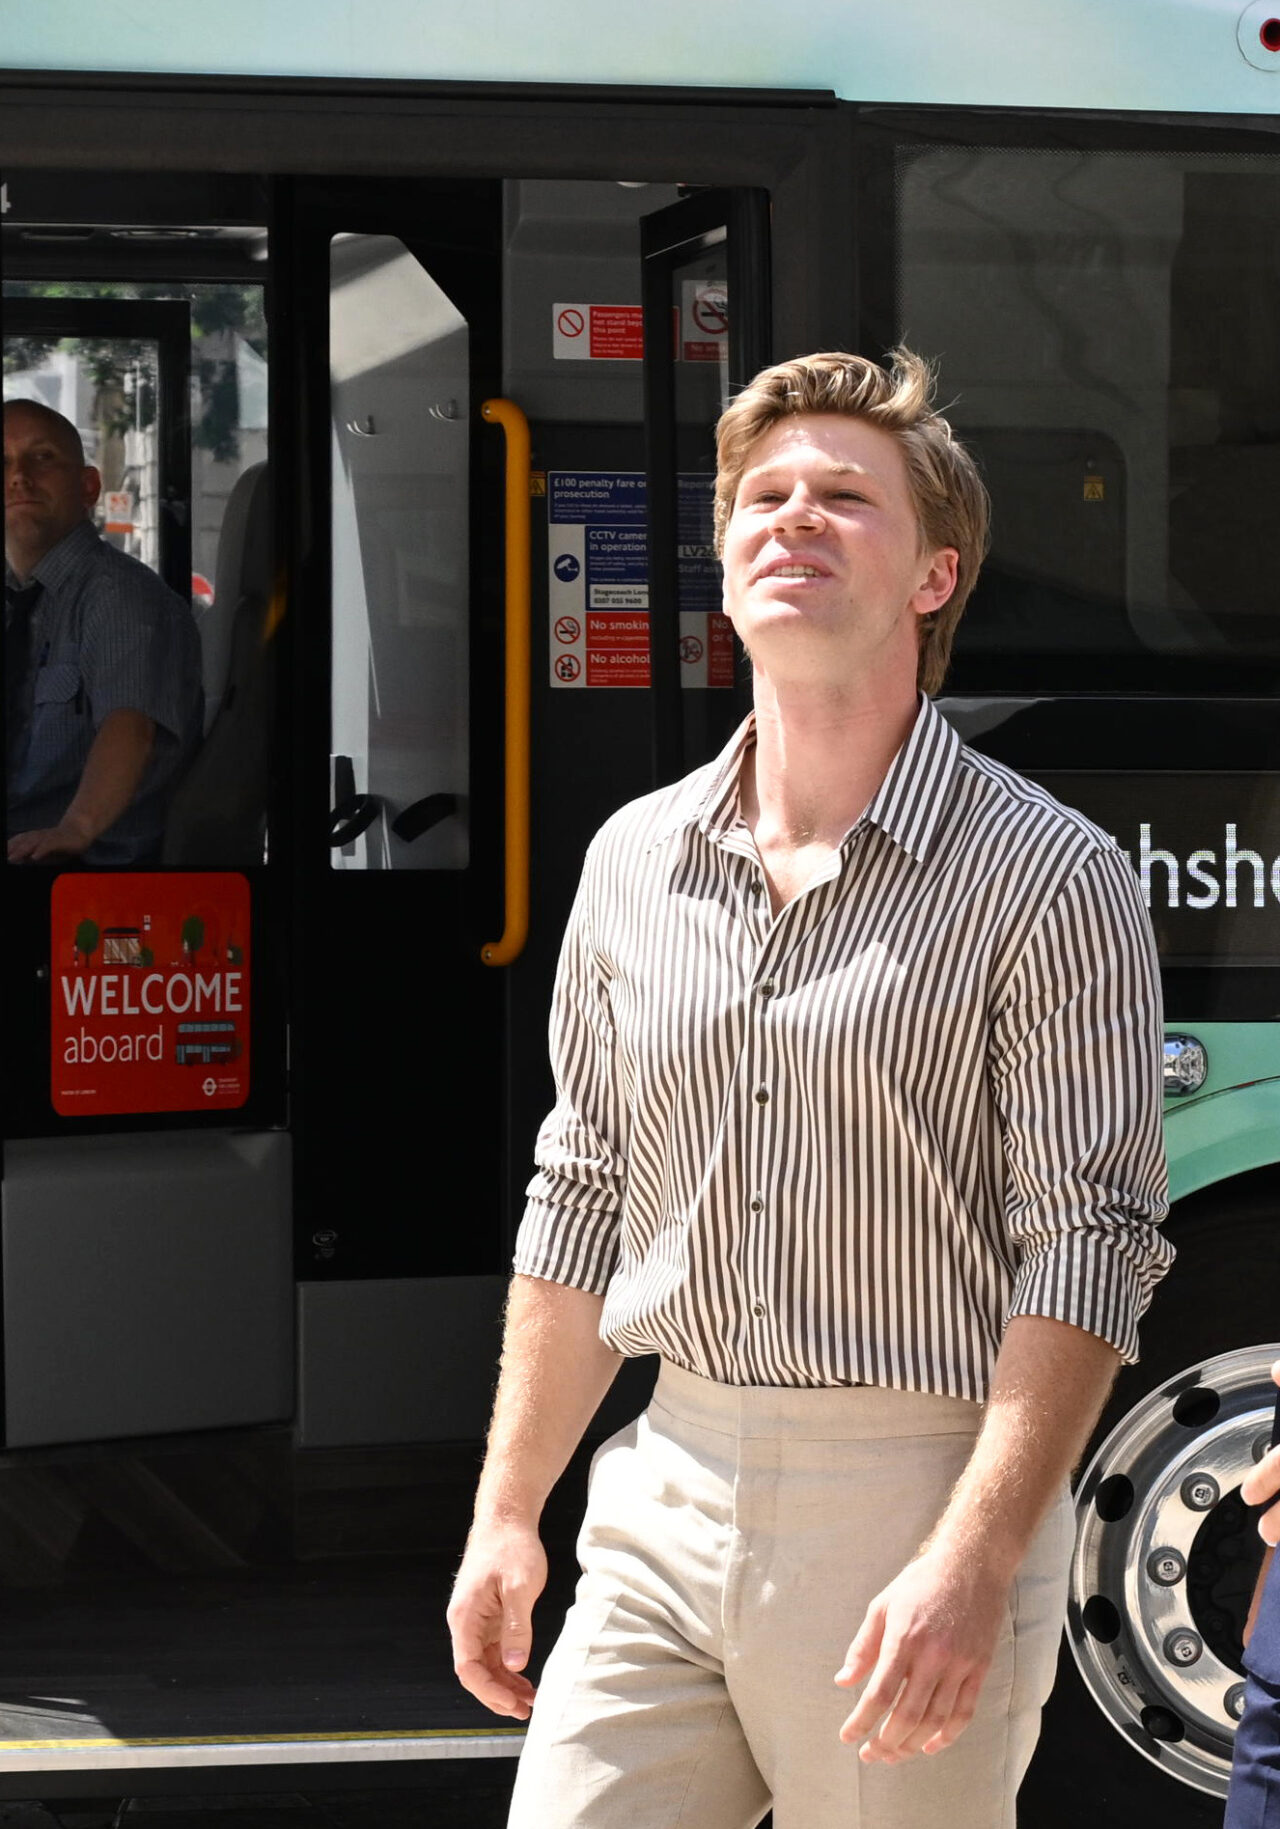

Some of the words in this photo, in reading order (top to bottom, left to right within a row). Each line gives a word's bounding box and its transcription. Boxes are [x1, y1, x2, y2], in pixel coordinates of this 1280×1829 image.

[553, 478, 577, 488] £100
[578, 478, 614, 490] penalty
[615, 478, 636, 488] fare
[553, 489, 610, 500] prosecution
[589, 530, 617, 541] CCTV
[589, 542, 599, 551] in
[600, 542, 647, 553] operation
[590, 620, 607, 630] No
[608, 619, 649, 630] smokin
[712, 619, 729, 629] No
[590, 653, 607, 664] No
[609, 653, 651, 664] alcohol
[61, 972, 243, 1016] WELCOME
[63, 1024, 164, 1064] aboard
